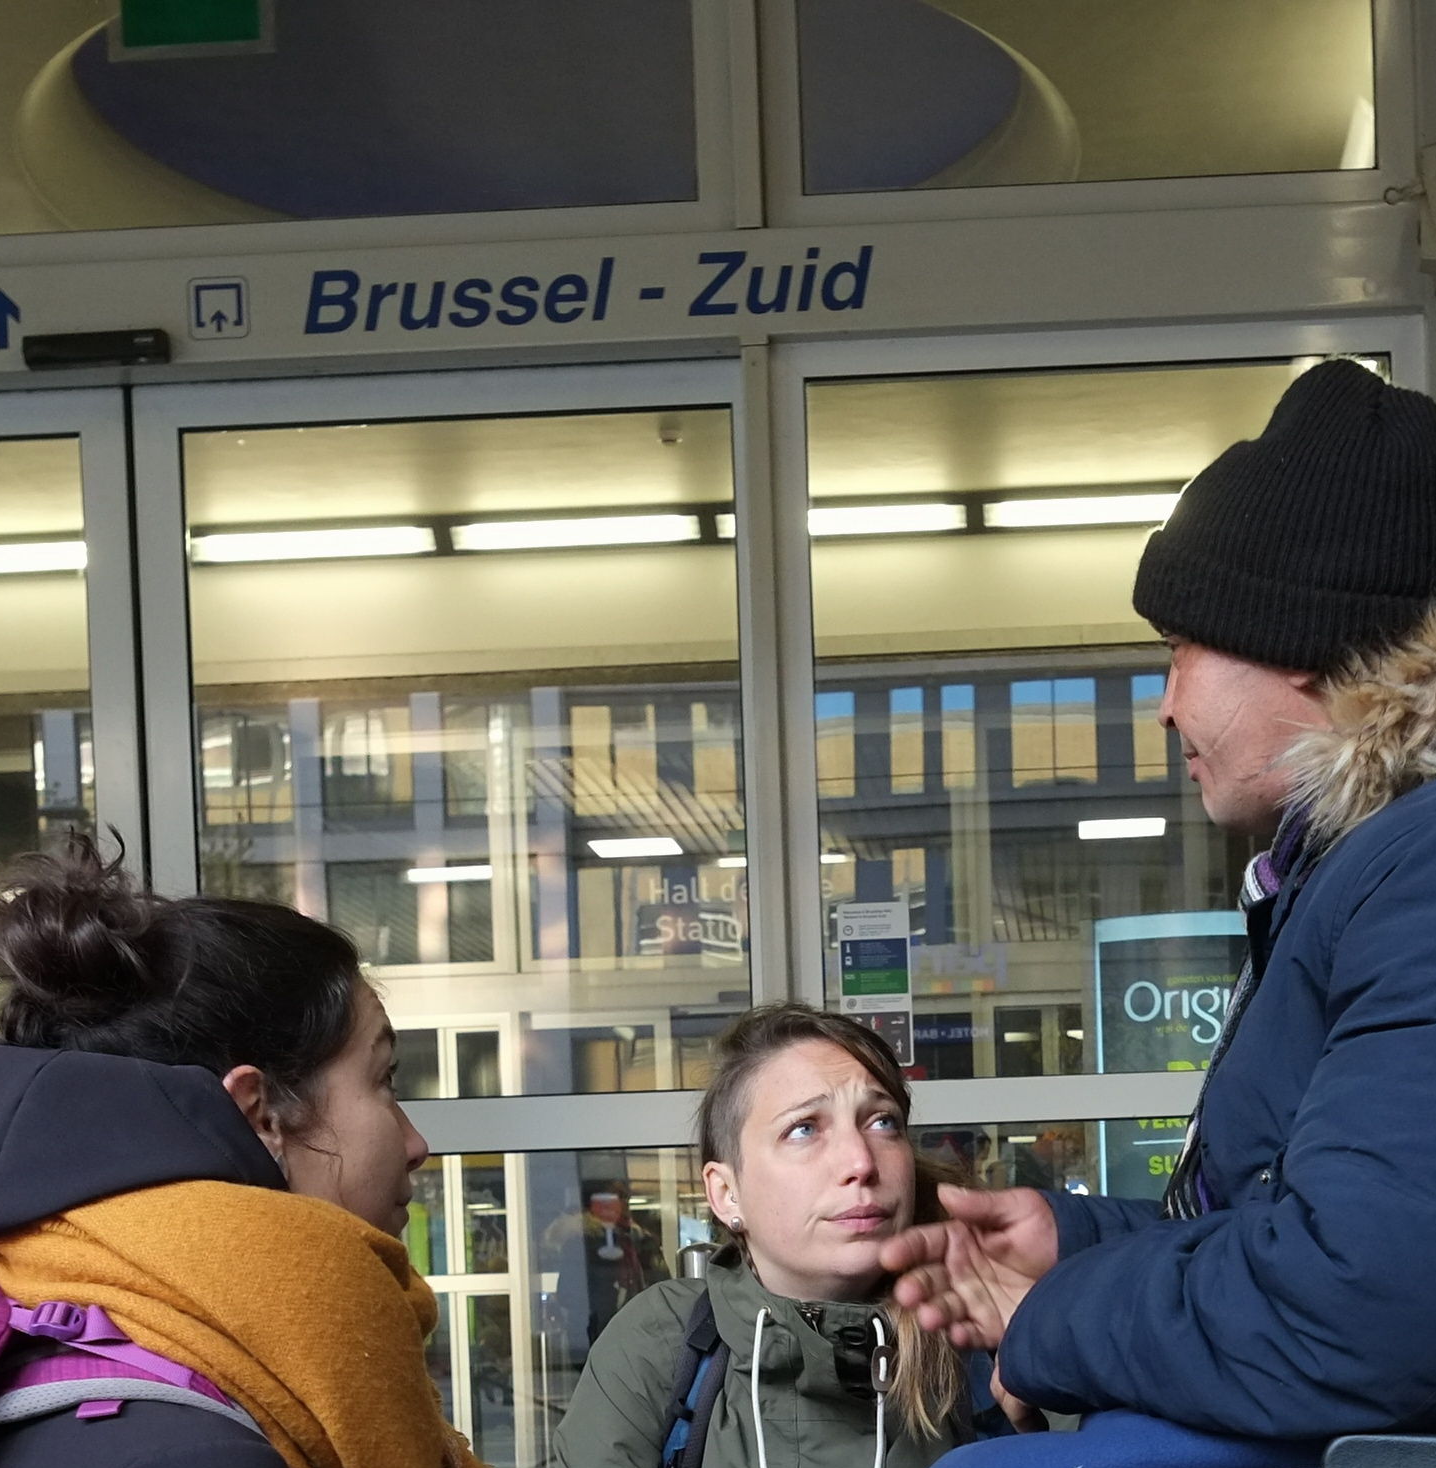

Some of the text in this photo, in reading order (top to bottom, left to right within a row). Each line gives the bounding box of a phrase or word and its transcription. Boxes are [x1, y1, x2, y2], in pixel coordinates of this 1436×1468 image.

[303, 245, 875, 336] Brussel - Zuid
[649, 876, 711, 904] Hall
